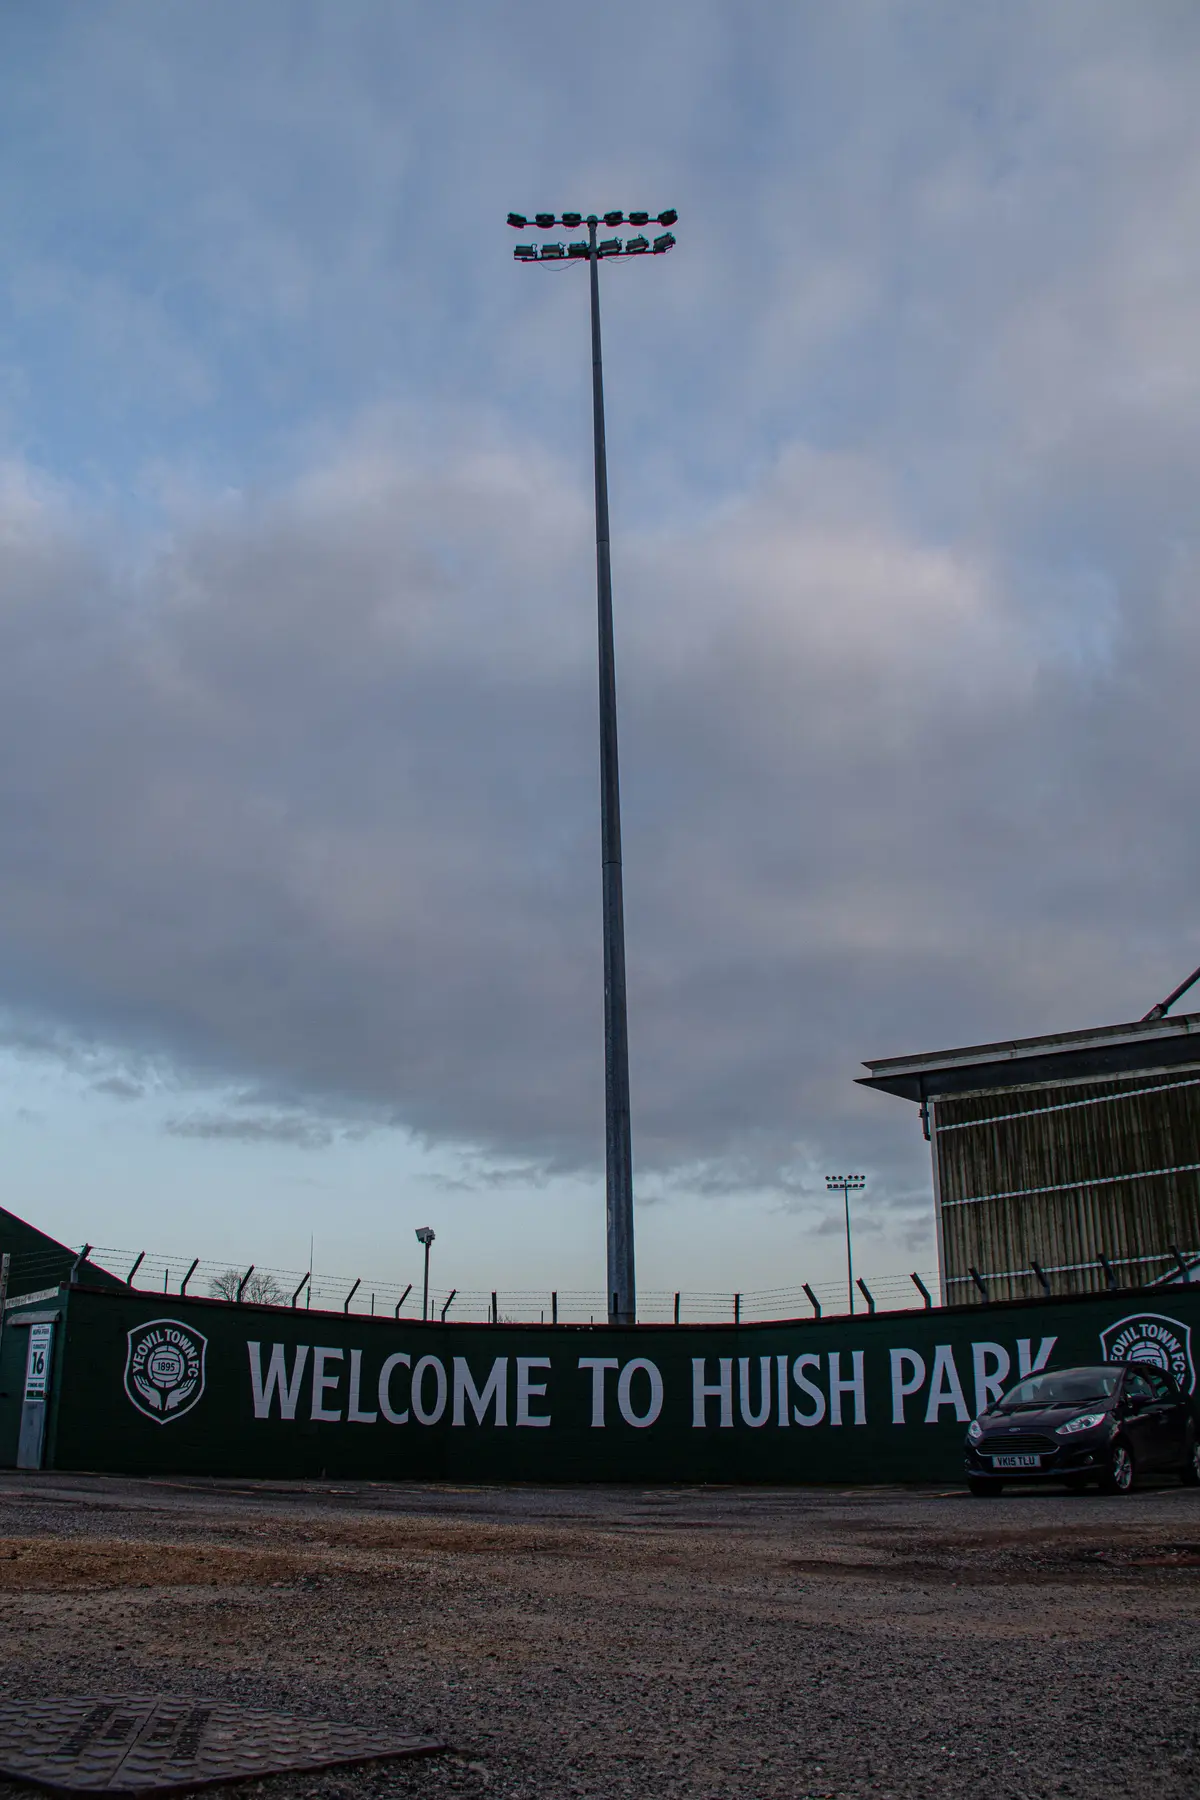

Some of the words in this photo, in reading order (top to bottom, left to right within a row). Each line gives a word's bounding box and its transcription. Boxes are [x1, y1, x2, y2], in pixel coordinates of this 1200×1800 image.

[32, 1351, 45, 1375] 16
[132, 1329, 165, 1374] YEOVIL
[164, 1328, 198, 1360] TOWN
[187, 1359, 200, 1378] FC
[1138, 1323, 1182, 1353] TOWN
[1170, 1351, 1187, 1372] FC
[157, 1361, 175, 1372] 1895
[246, 1340, 552, 1428] WELCOME
[577, 1356, 664, 1429] TO
[691, 1349, 868, 1428] HUISH
[997, 1456, 1016, 1467] VK15
[1017, 1456, 1035, 1465] TLU
